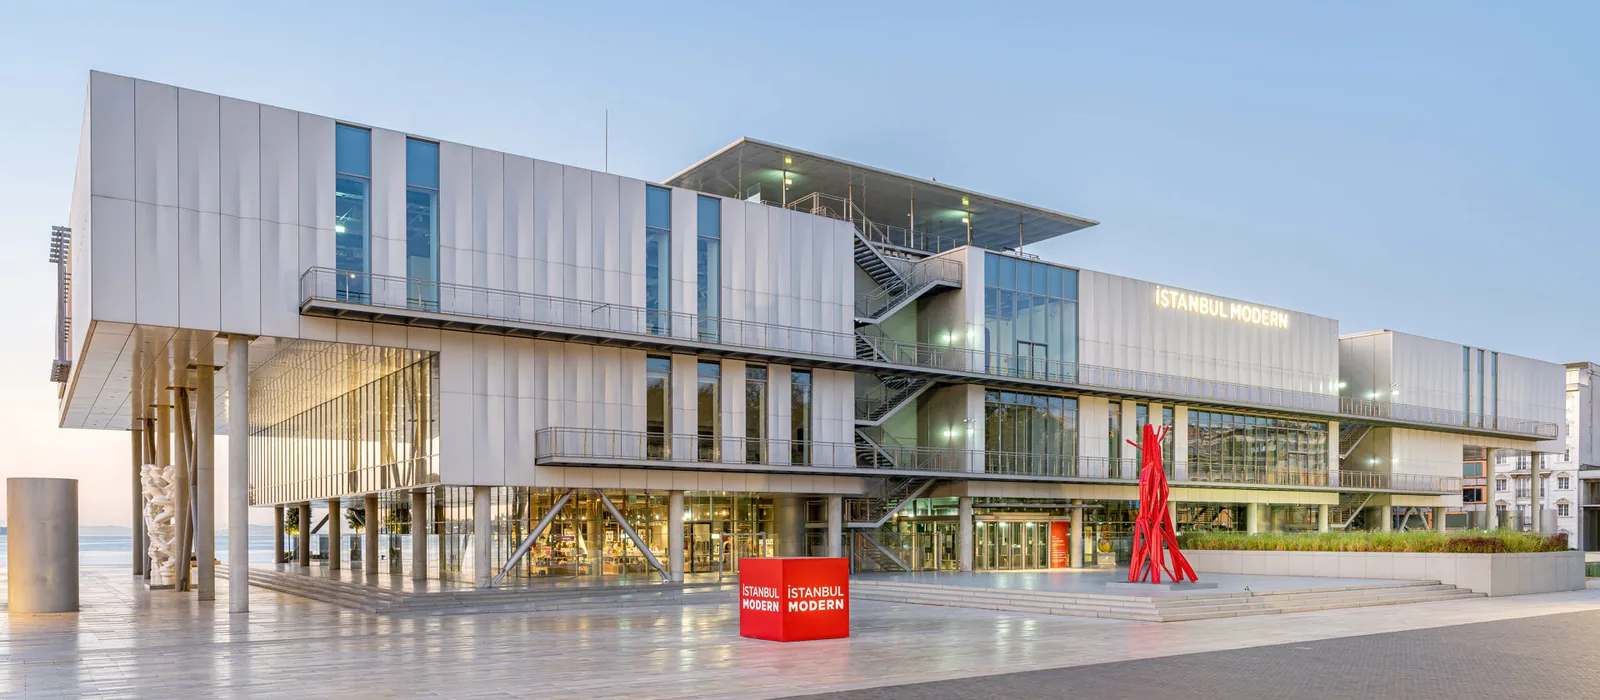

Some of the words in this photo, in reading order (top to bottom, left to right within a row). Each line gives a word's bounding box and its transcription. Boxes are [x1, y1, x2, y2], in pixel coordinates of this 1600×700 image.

[1155, 285, 1228, 318] İSTANBUL
[1230, 303, 1288, 328] MODERN
[742, 584, 779, 598] İSTANBUL
[788, 585, 844, 598] İSTANBUL
[743, 599, 779, 612] MODERN
[788, 599, 844, 612] MODERN
